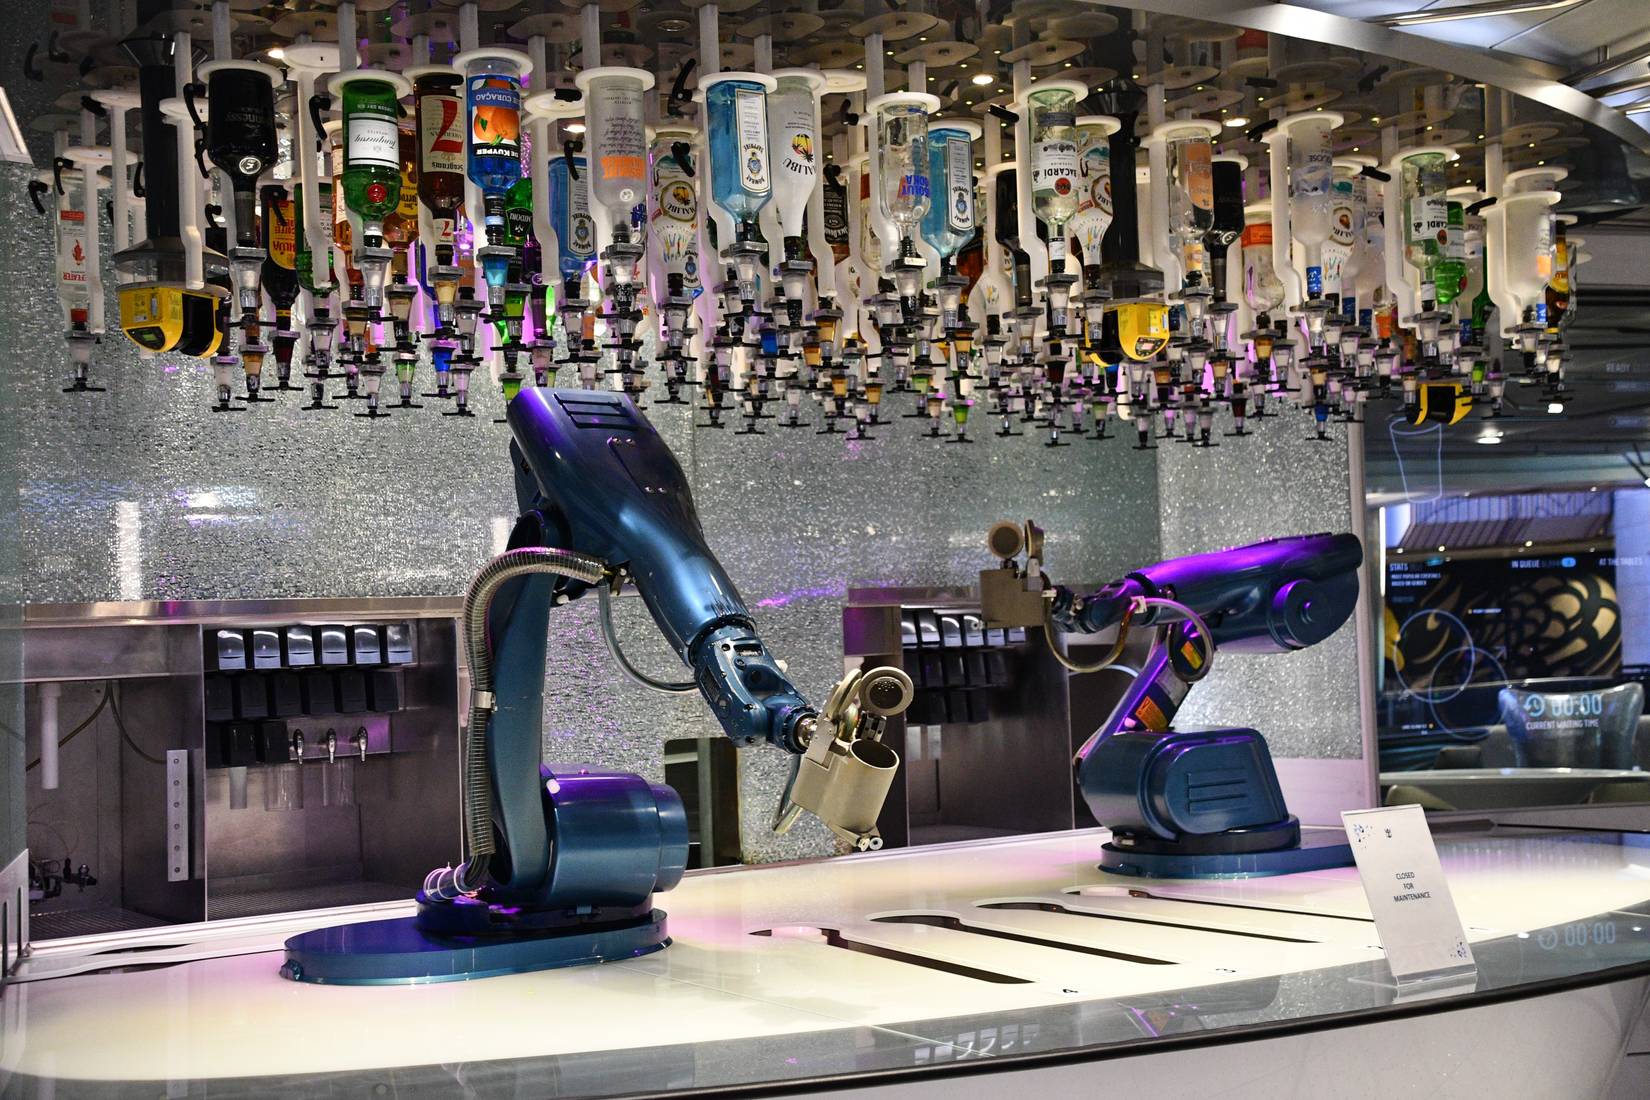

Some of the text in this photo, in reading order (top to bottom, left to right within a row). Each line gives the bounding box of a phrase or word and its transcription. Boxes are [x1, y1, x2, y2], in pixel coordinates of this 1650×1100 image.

[475, 92, 512, 102] CURAÇAO
[429, 99, 464, 154] 7
[353, 134, 397, 150] Tanqueray
[475, 148, 511, 156] KUYPER
[1525, 720, 1554, 731] CURRENT
[1395, 871, 1415, 880] CLOSED
[1402, 882, 1414, 890] FOR
[1393, 891, 1432, 903] MAINTENANCE
